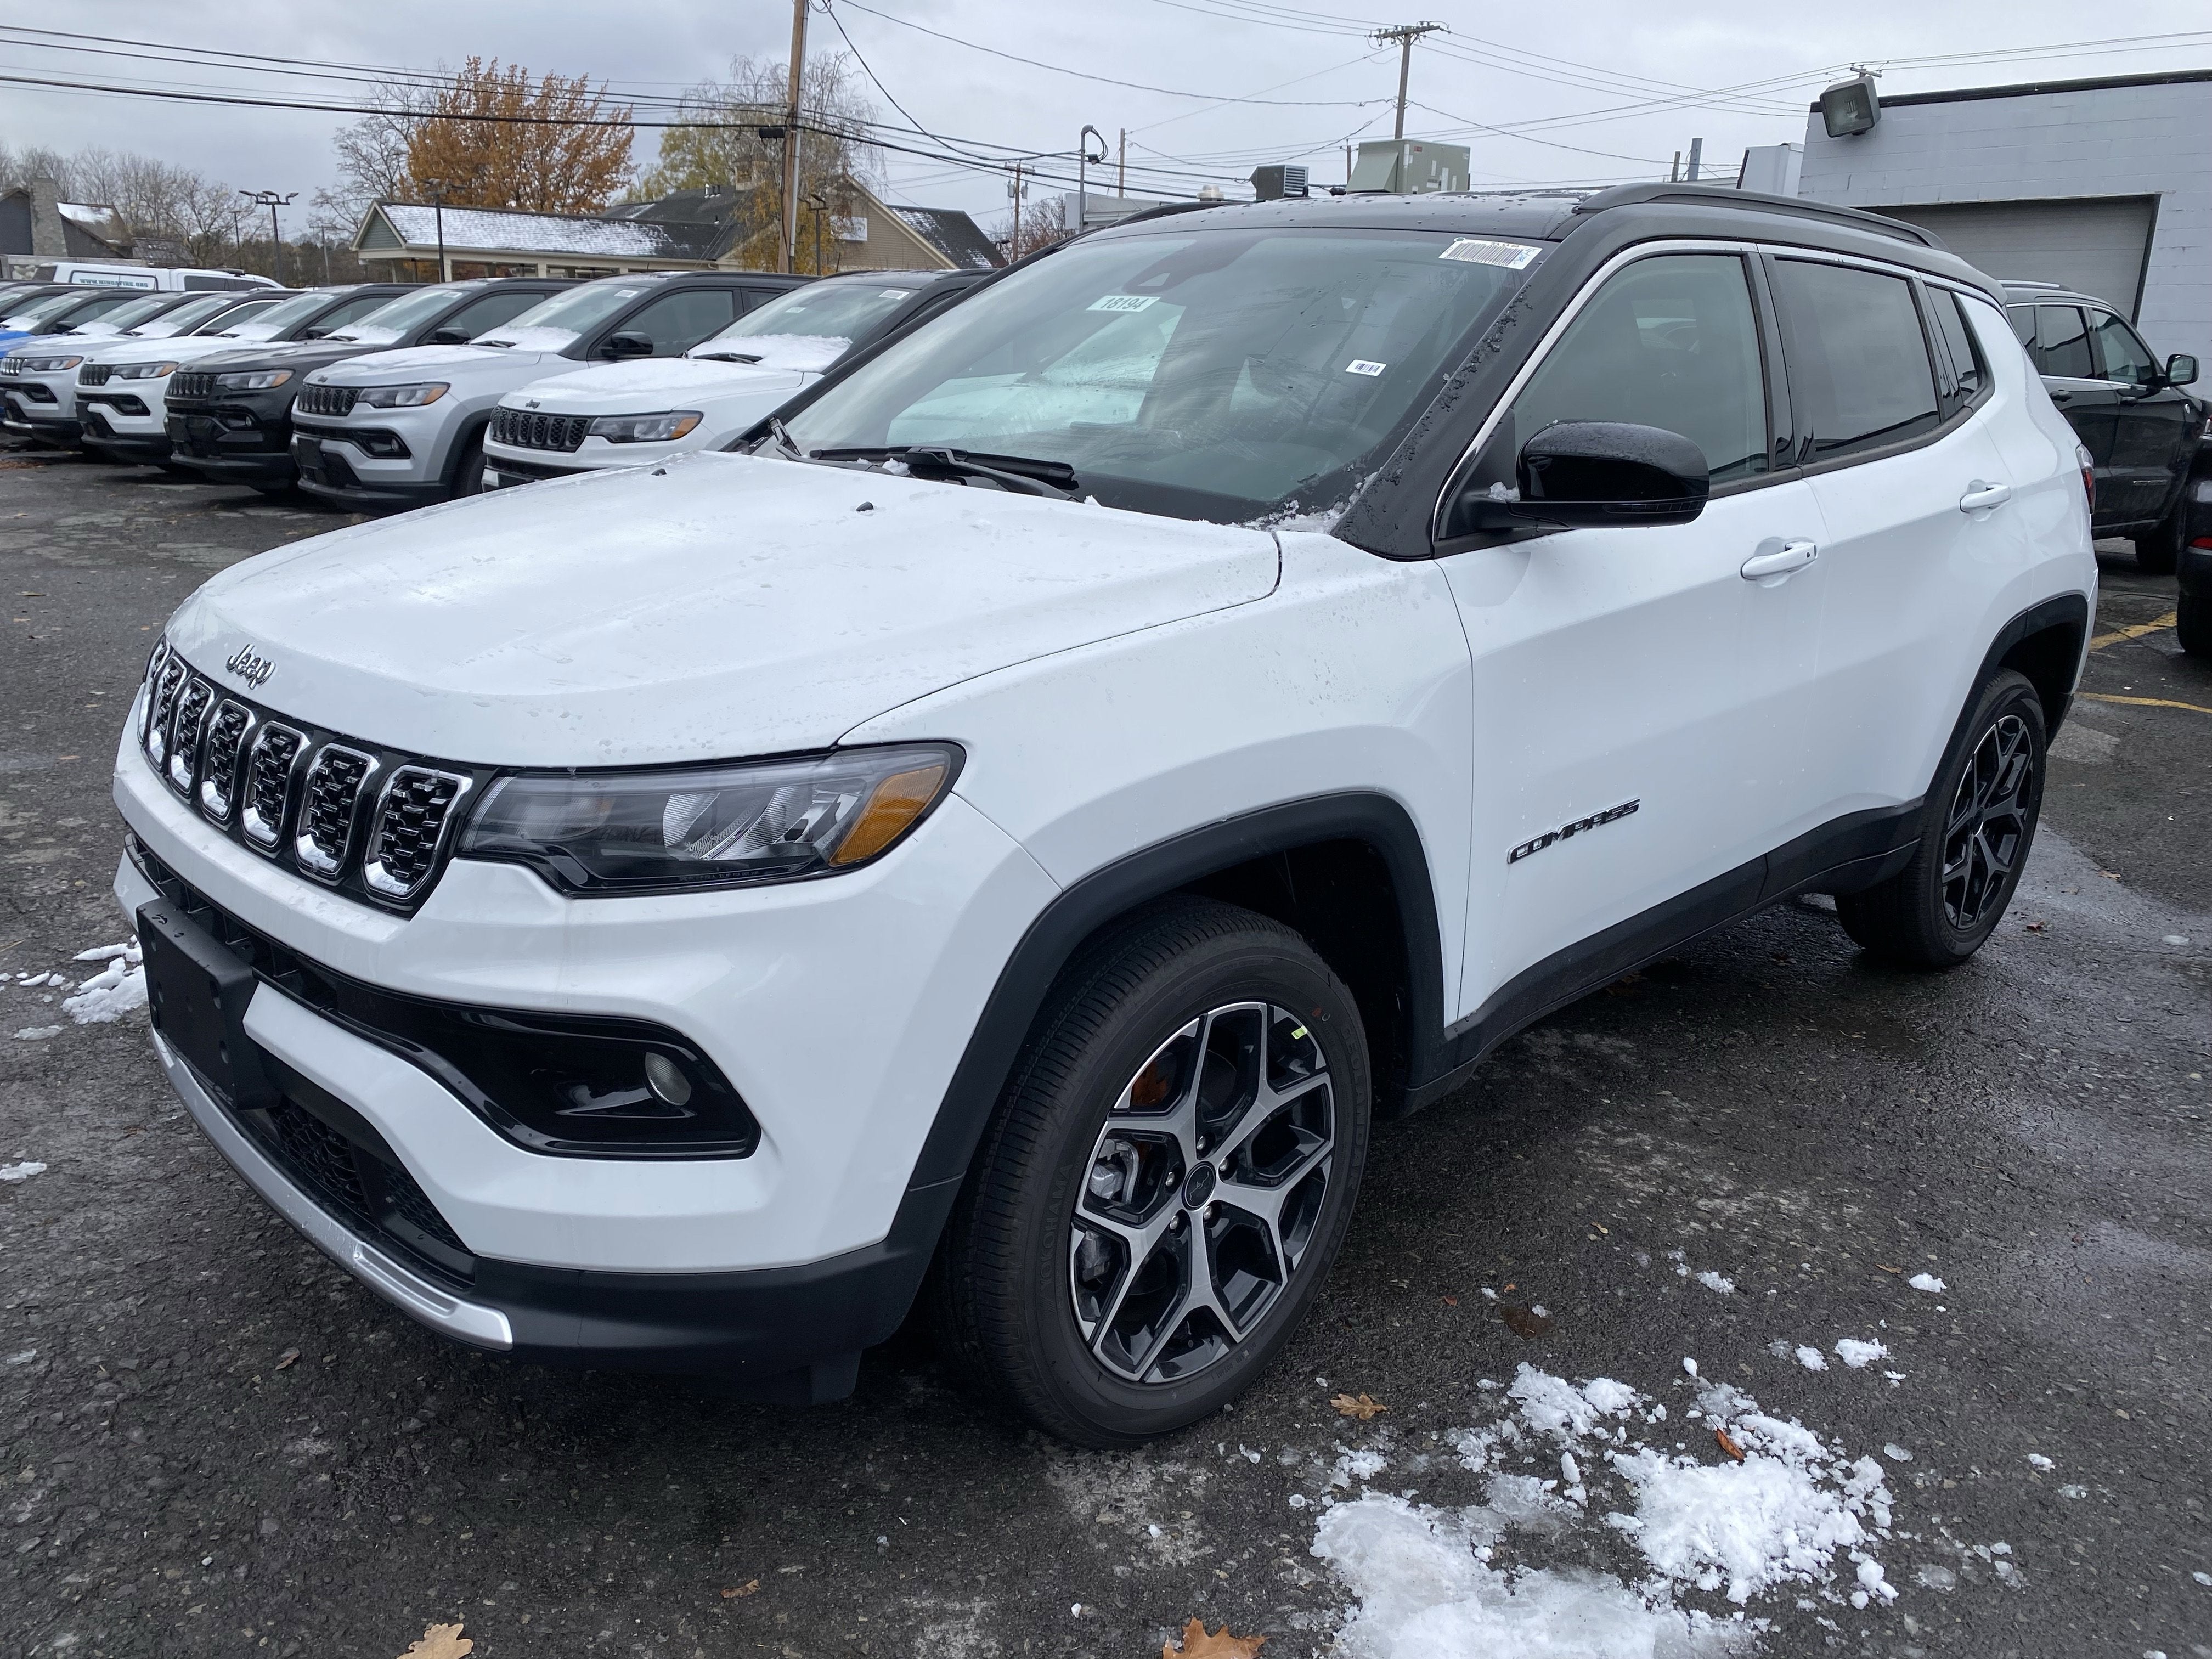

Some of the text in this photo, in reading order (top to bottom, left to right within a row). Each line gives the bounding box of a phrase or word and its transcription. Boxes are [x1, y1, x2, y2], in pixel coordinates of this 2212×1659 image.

[1101, 297, 1149, 310] 18194
[225, 644, 276, 690] Jeep
[1506, 797, 1640, 865] COMPASS
[1040, 1164, 1073, 1291] YOKOHAMA
